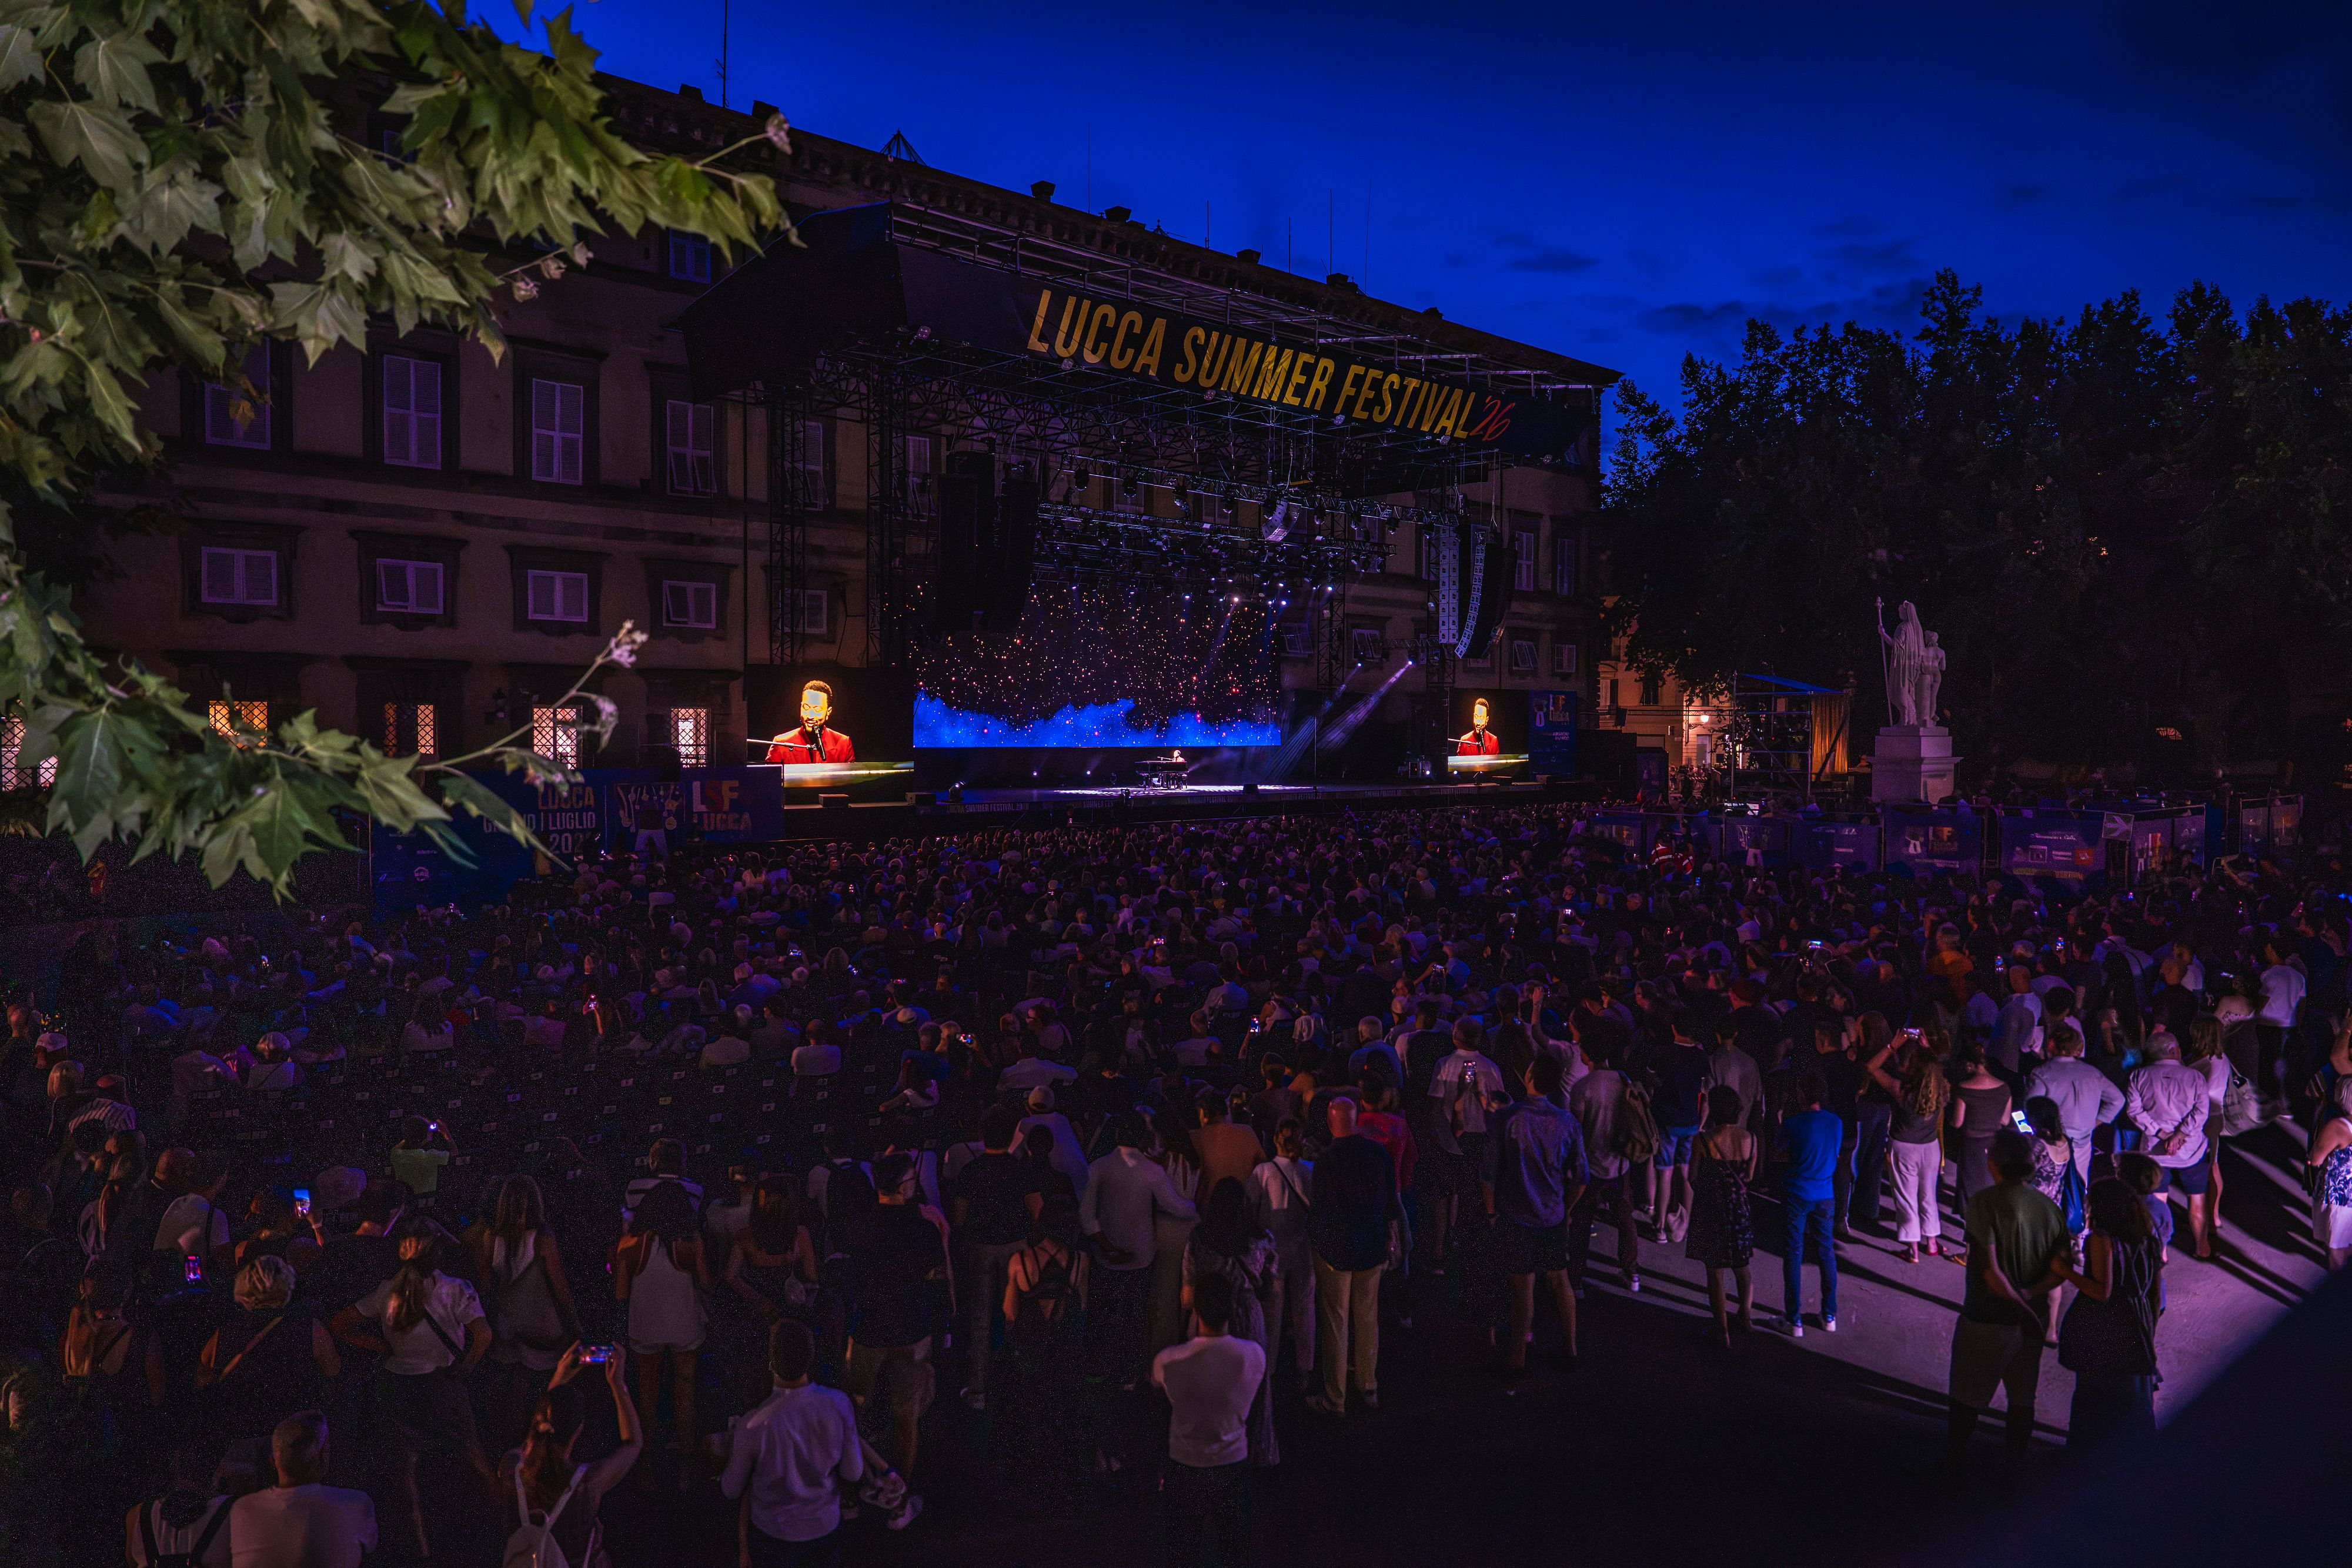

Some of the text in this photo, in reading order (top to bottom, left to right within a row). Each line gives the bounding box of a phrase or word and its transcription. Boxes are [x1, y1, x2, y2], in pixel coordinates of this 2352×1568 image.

[1027, 289, 1168, 380] LUCCA
[1174, 326, 1335, 412] SUMMER
[1335, 365, 1476, 440] FESTIVAL
[692, 779, 740, 813] LSF
[965, 804, 989, 813] SUMMER
[990, 803, 1014, 812] FESTIVAL
[548, 811, 596, 831] LUGLIO
[549, 832, 593, 854] 202
